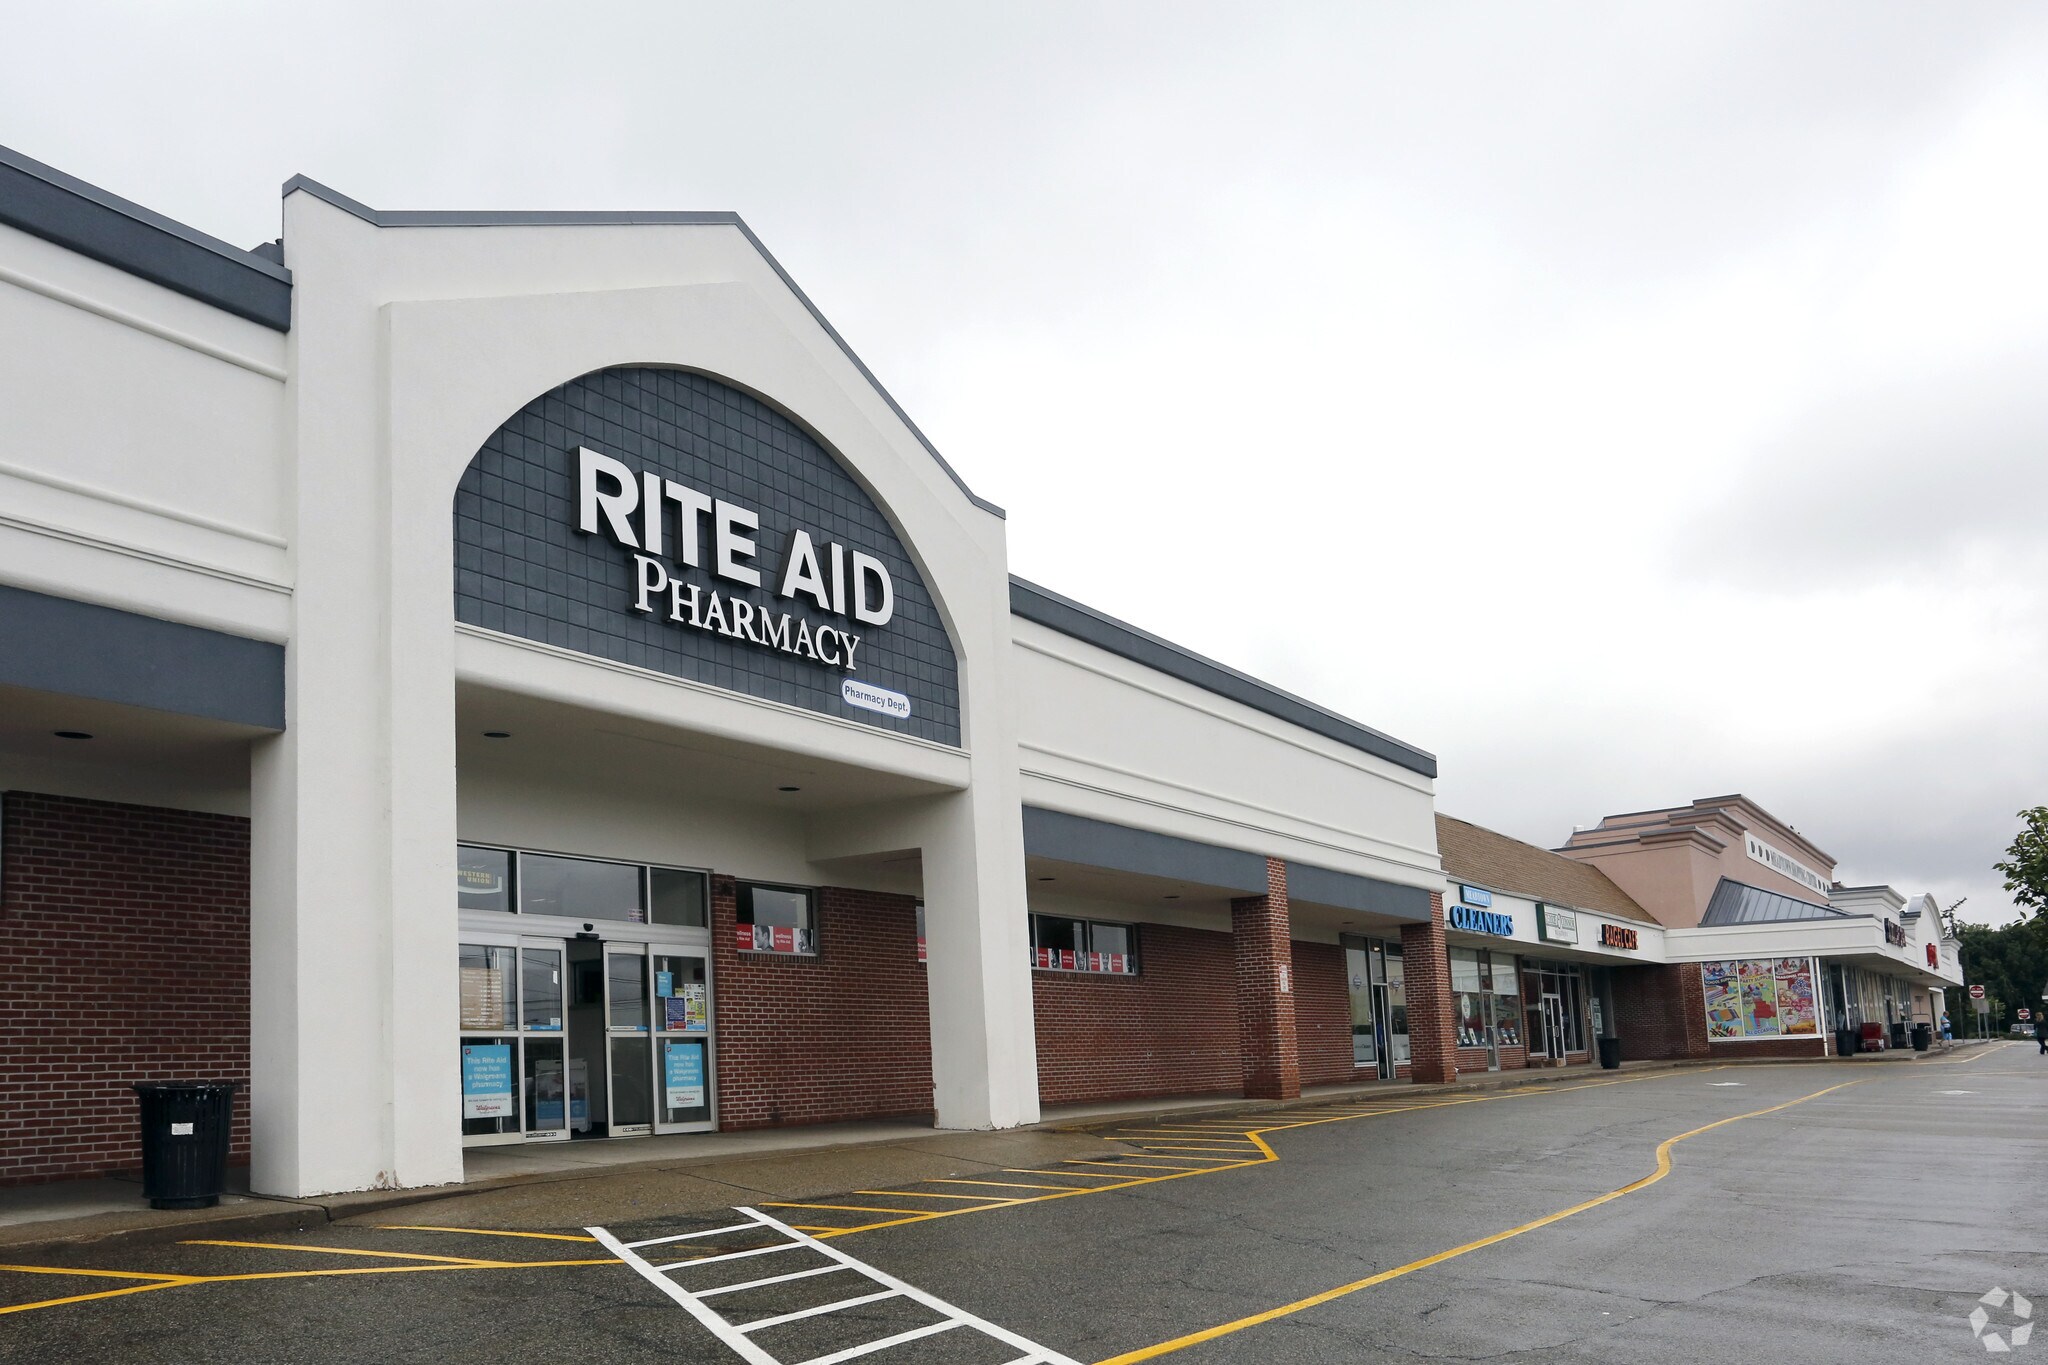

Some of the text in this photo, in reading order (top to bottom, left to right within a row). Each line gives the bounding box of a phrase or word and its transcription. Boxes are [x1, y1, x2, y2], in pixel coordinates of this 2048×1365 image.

[577, 445, 894, 627] RITE AID
[632, 553, 861, 671] PHARMACY
[844, 685, 908, 712] Pharmacy Dept.
[1451, 905, 1514, 937] CLEANERS
[1603, 924, 1639, 951] BAGEL CAFE
[473, 1073, 507, 1081] Walgreens
